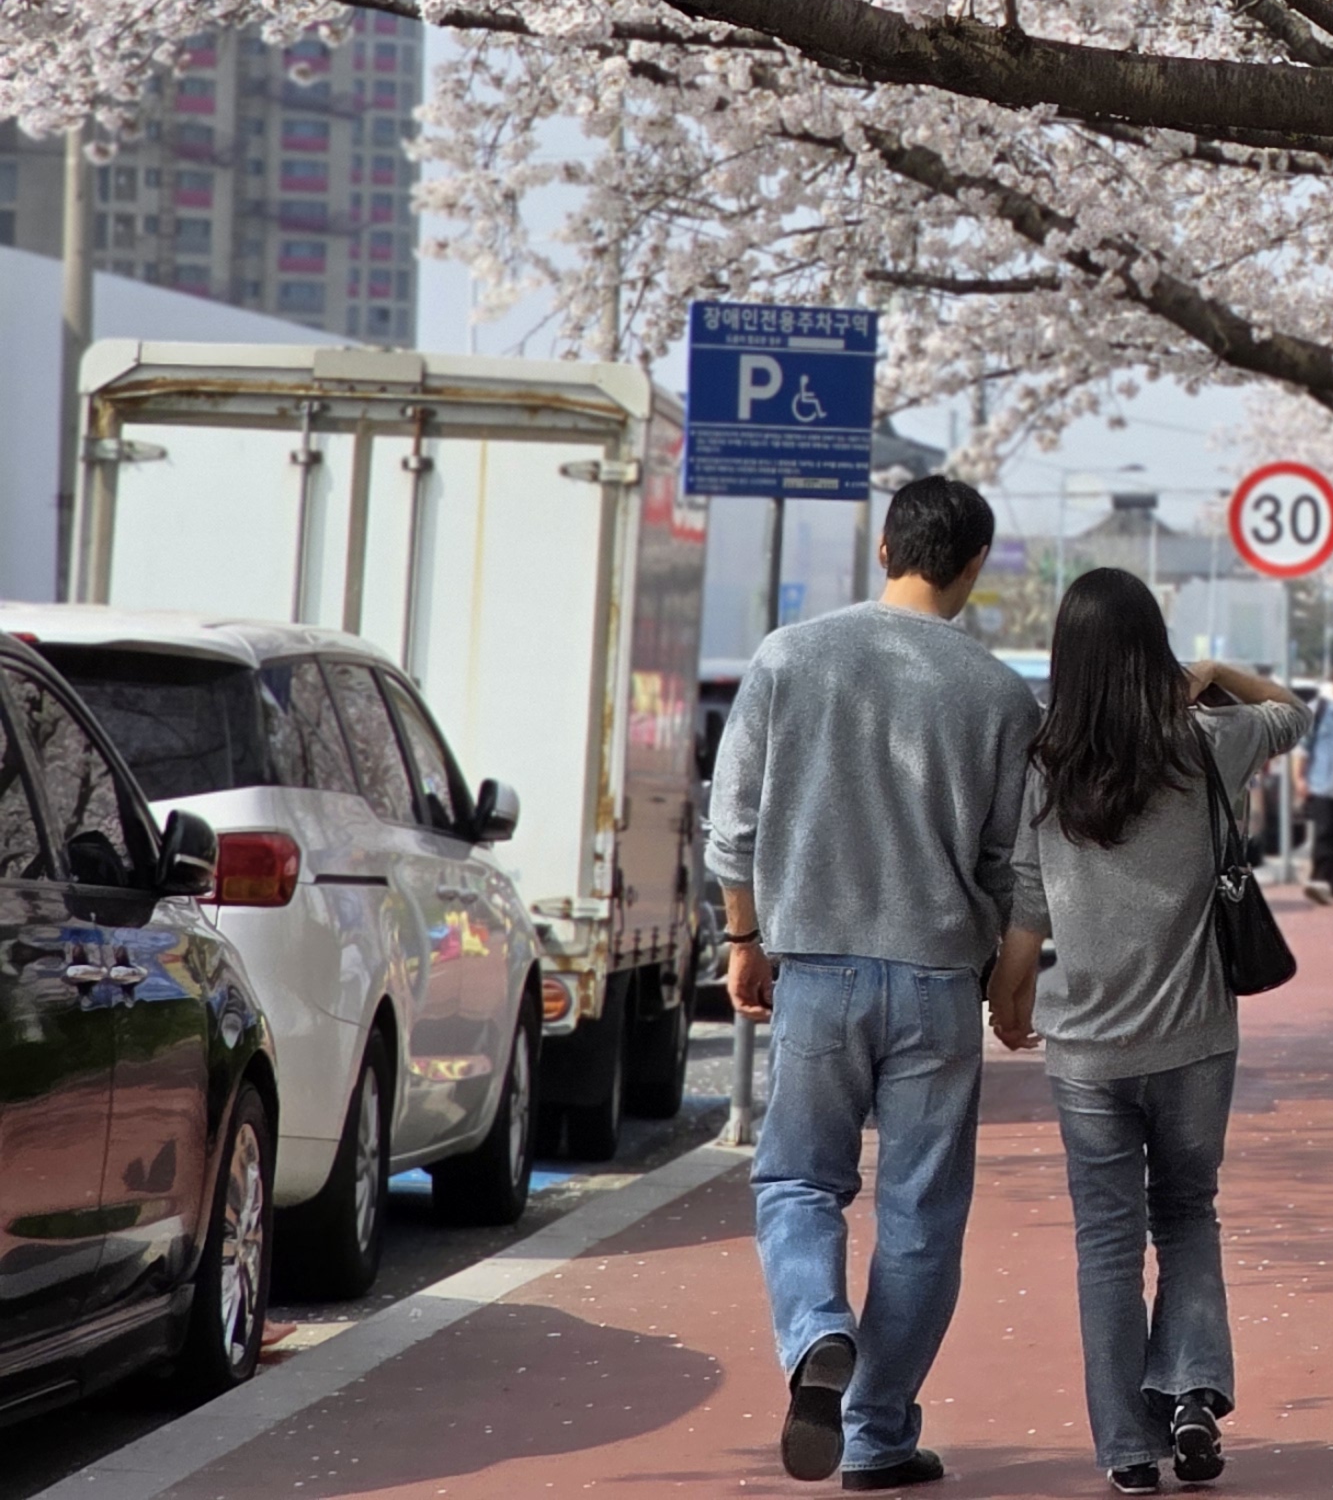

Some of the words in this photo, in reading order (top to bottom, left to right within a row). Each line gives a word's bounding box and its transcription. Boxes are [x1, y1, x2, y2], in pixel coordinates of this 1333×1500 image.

[702, 305, 869, 338] 장애인전용주차구역
[738, 354, 783, 420] P
[1252, 493, 1322, 546] 30
